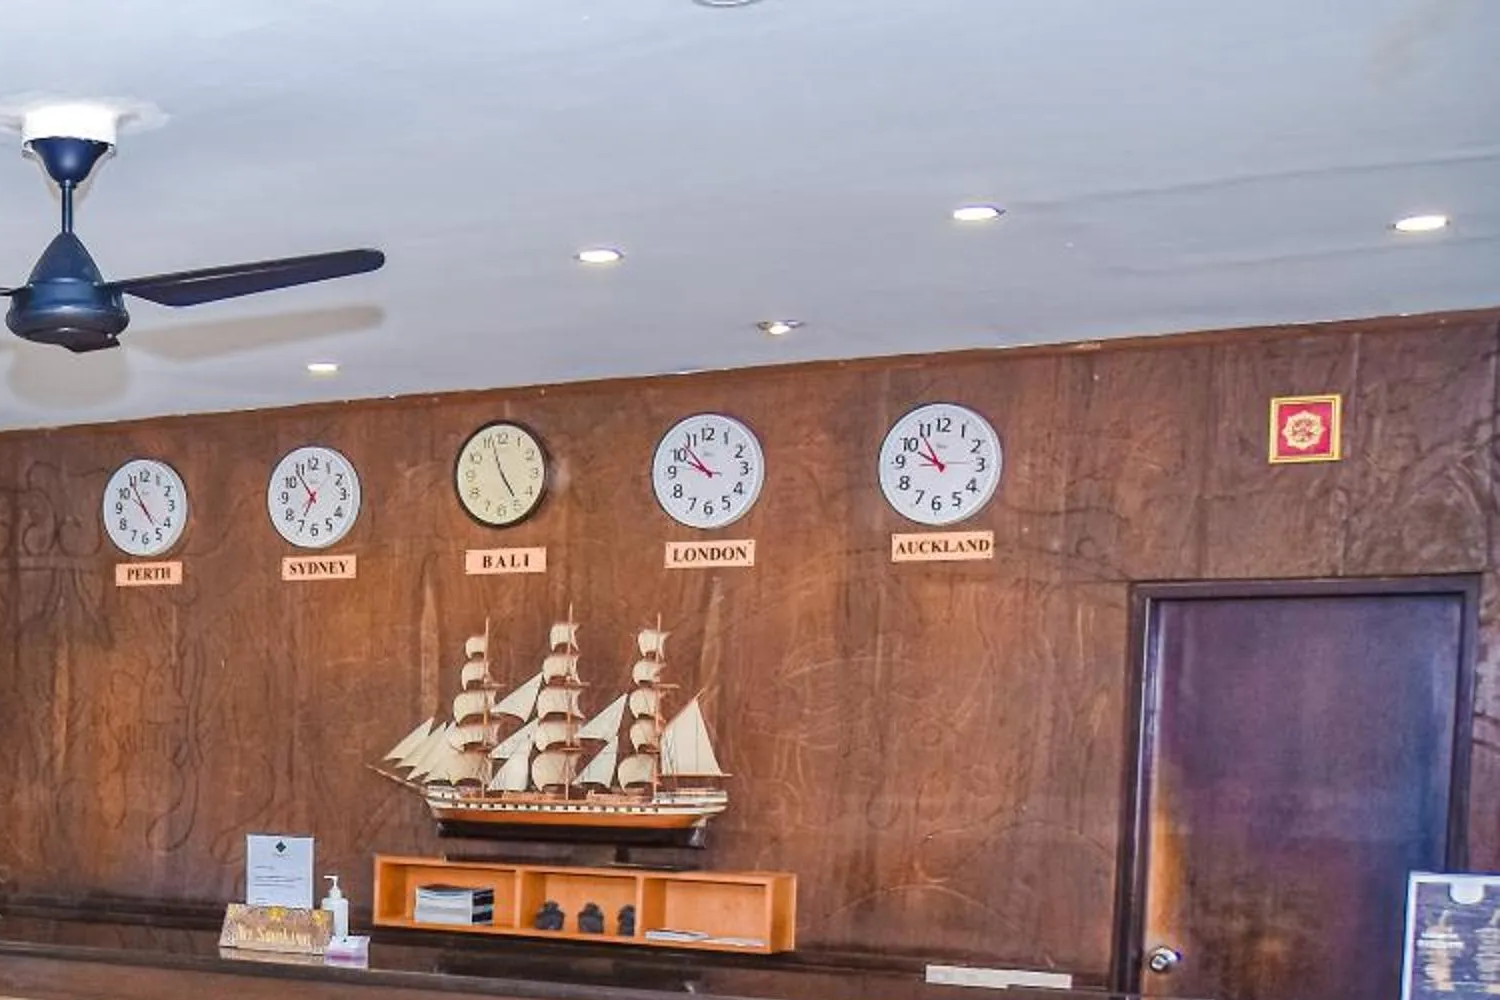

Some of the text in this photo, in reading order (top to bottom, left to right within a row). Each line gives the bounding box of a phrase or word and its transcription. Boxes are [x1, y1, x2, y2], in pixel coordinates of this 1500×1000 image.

[936, 418, 951, 433] 12
[701, 428, 714, 441] 12
[903, 437, 918, 452] 10
[970, 439, 981, 453] 2
[673, 448, 687, 462] 10
[735, 446, 743, 458] 2
[308, 457, 319, 471] 12
[740, 461, 749, 475] 3
[895, 455, 905, 468] 9
[976, 458, 985, 472] 3
[668, 465, 677, 479] 9
[285, 476, 297, 488] 10
[335, 474, 342, 486] 2
[899, 475, 910, 490] 8
[966, 478, 976, 492] 4
[340, 487, 346, 500] 3
[673, 484, 683, 498] 8
[734, 482, 743, 495] 4
[281, 492, 289, 504] 9
[688, 497, 697, 511] 7
[721, 496, 731, 510] 5
[916, 490, 925, 505] 7
[931, 496, 941, 511] 6
[952, 492, 962, 507] 5
[286, 508, 294, 521] 8
[334, 506, 342, 518] 4
[703, 501, 713, 515] 6
[298, 520, 305, 532] 7
[310, 524, 318, 537] 6
[325, 518, 333, 531] 5
[673, 546, 748, 562] LONDON
[896, 539, 990, 556] AUCKLAND
[289, 560, 349, 576] SYDNEY
[483, 553, 530, 569] BALI
[127, 567, 171, 581] PERTH
